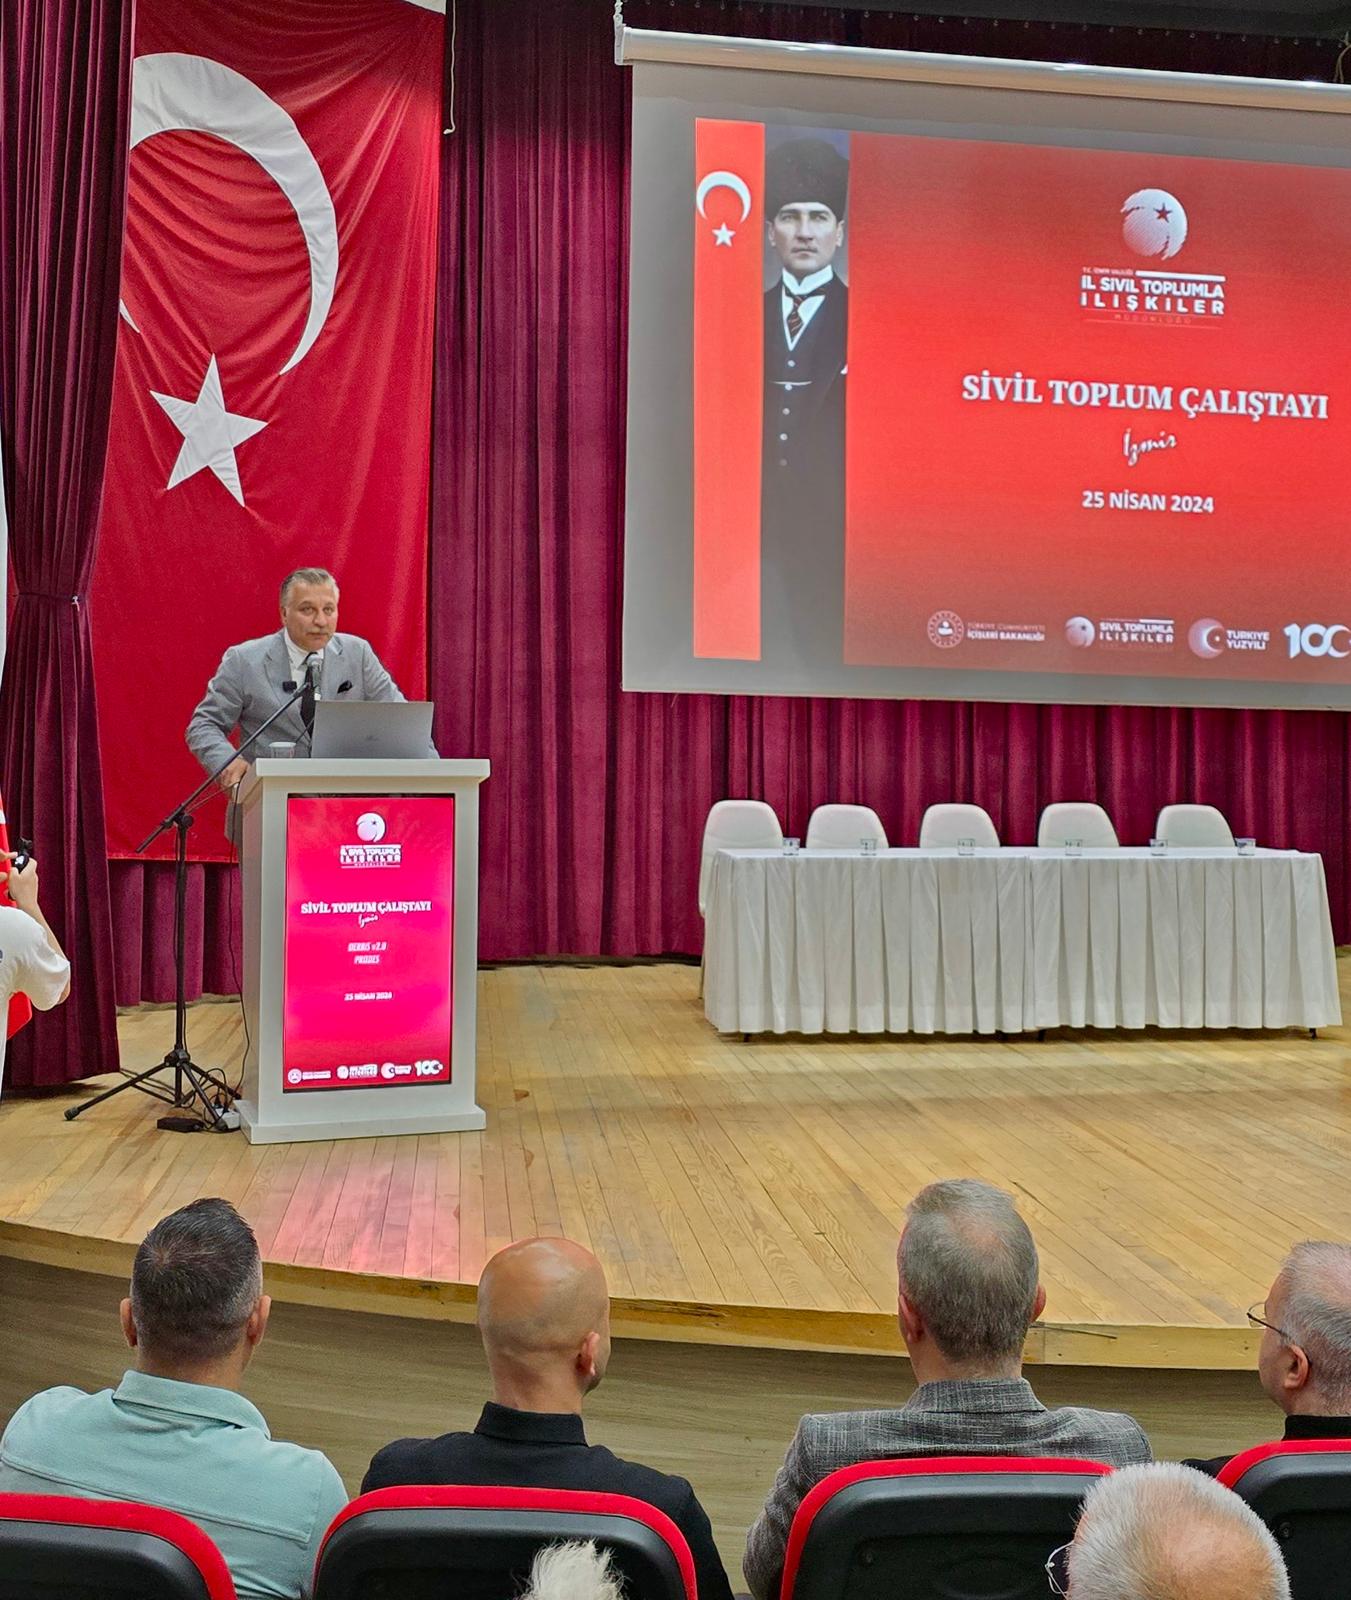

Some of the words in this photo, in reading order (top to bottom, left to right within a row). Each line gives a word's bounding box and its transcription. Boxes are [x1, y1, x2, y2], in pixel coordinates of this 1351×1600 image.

[1100, 277, 1140, 293] SİVİL
[1141, 279, 1225, 298] TOPLUMLA
[962, 369, 1043, 403] SİVİL
[1048, 380, 1173, 411] TOPLUM
[1179, 387, 1329, 422] ÇALIŞTAYI
[1123, 428, 1177, 466] İzmir
[1082, 491, 1105, 509] 25
[1109, 489, 1167, 511] NİSAN
[1171, 494, 1215, 513] 2024
[1124, 623, 1174, 635] TOPLUMLA
[301, 901, 331, 914] SİVİL
[331, 901, 377, 914] TOPLUM
[377, 901, 432, 914] ÇALIŞTAYI
